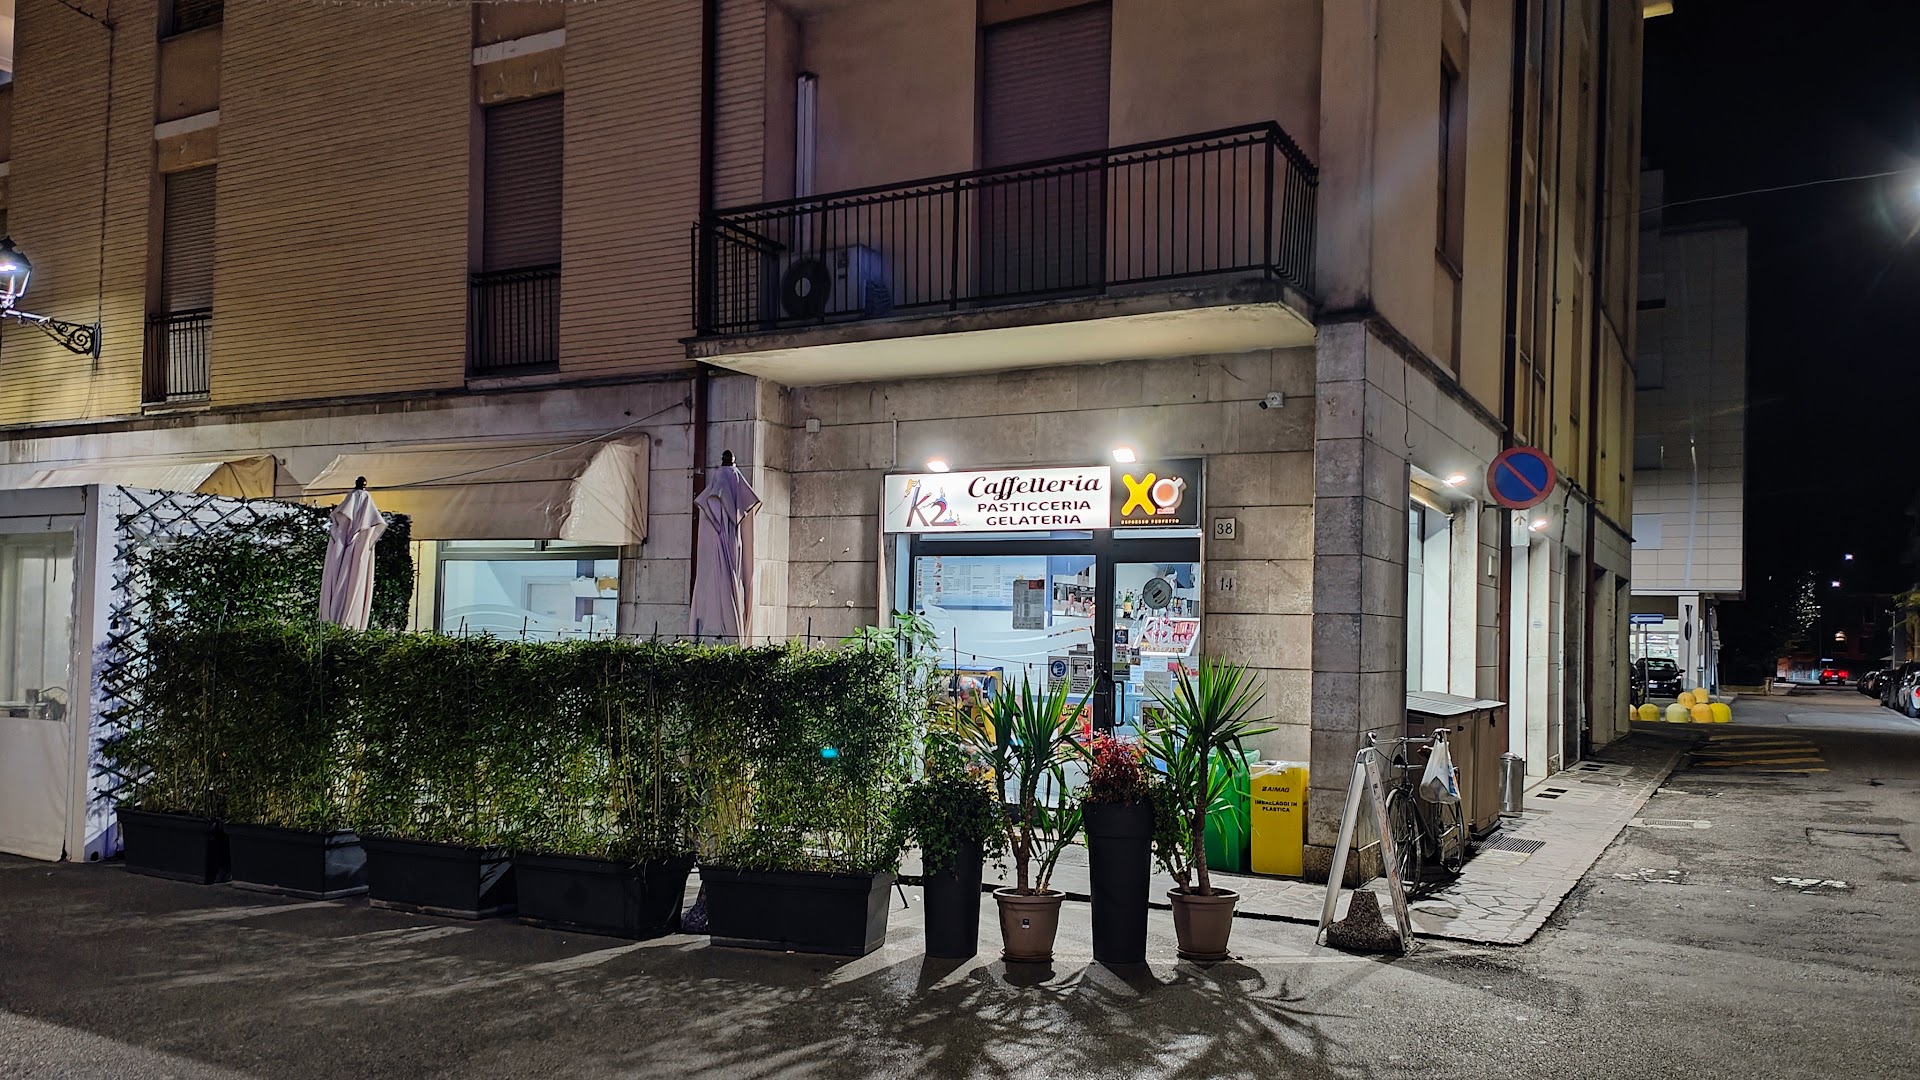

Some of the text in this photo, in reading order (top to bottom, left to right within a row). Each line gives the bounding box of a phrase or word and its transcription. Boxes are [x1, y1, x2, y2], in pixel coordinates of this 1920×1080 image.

[967, 474, 1103, 501] Caffetteria
[905, 480, 958, 528] K2
[977, 500, 1092, 513] PASTICCERIA
[986, 514, 1082, 526] GELATERIA
[1216, 522, 1233, 535] 38
